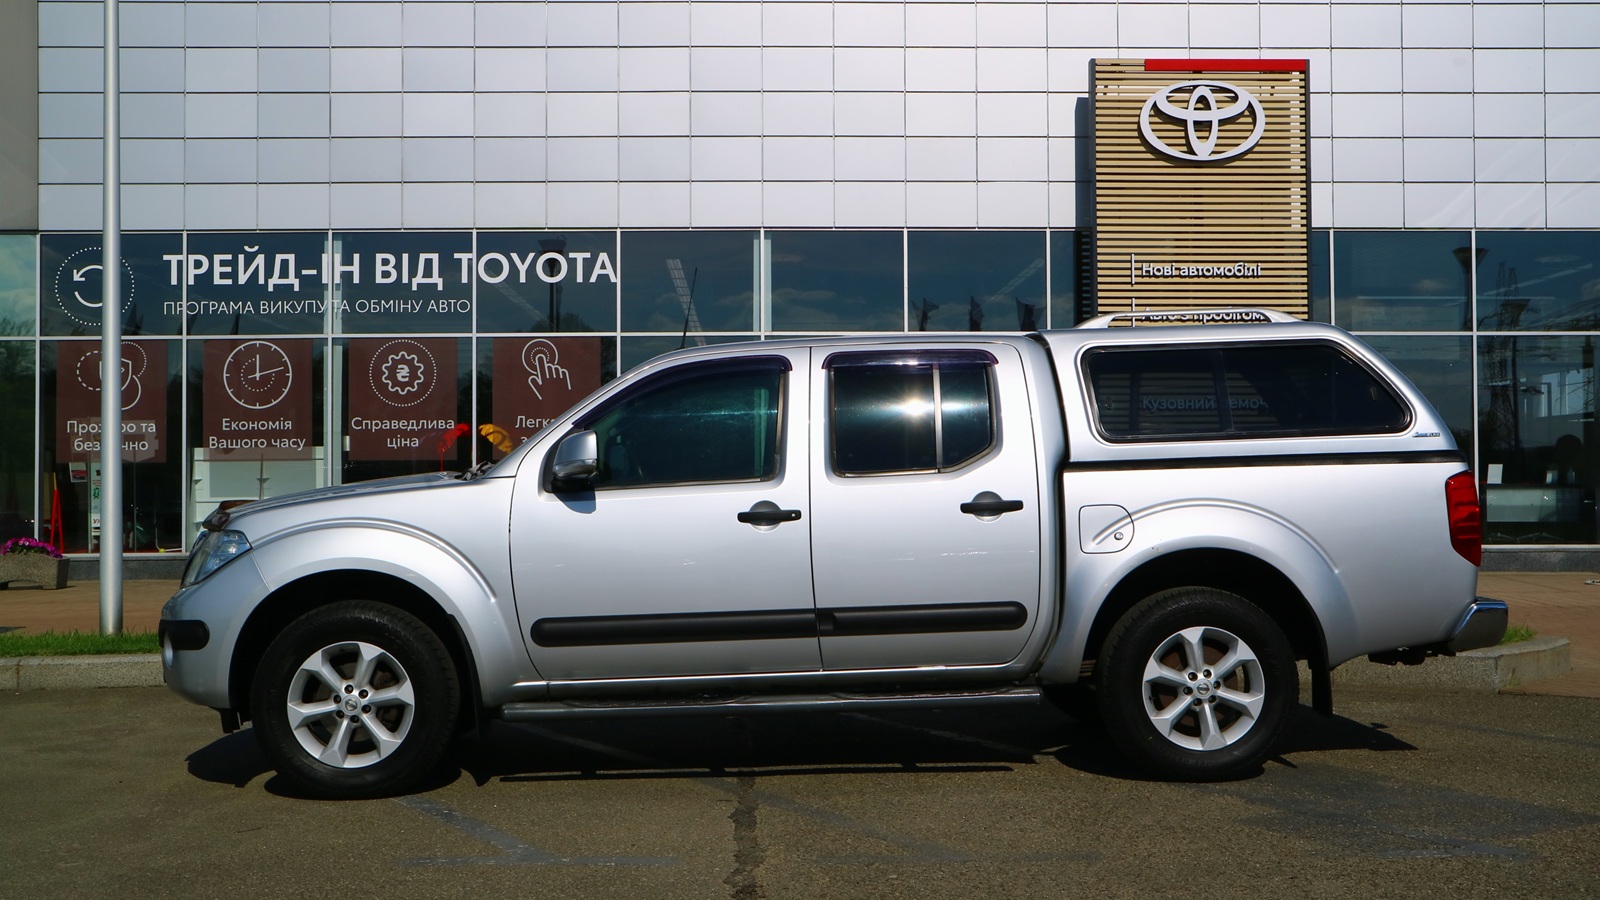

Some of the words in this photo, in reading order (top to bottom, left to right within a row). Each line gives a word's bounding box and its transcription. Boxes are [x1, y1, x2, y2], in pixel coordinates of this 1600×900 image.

[163, 246, 360, 291] ТРЕЙД-ІН
[375, 253, 443, 291] ВІД
[454, 252, 617, 284] TOYOTA
[1142, 263, 1176, 276] Нові
[1180, 262, 1262, 276] автомобілі
[164, 302, 255, 315] ПРОГРАМА
[261, 300, 327, 314] ВИКУПУ
[332, 300, 351, 313] ТА
[355, 300, 423, 313] ОБМІНУ
[427, 300, 471, 313] АВТО
[1143, 395, 1215, 412] Кузовний
[141, 423, 156, 433] та
[222, 418, 292, 431] Економія
[351, 417, 455, 433] Справедлива
[515, 415, 555, 428] Легк
[74, 438, 149, 451] безчно
[209, 436, 269, 449] Вашого
[271, 438, 306, 451] часу
[387, 435, 419, 449] ціна
